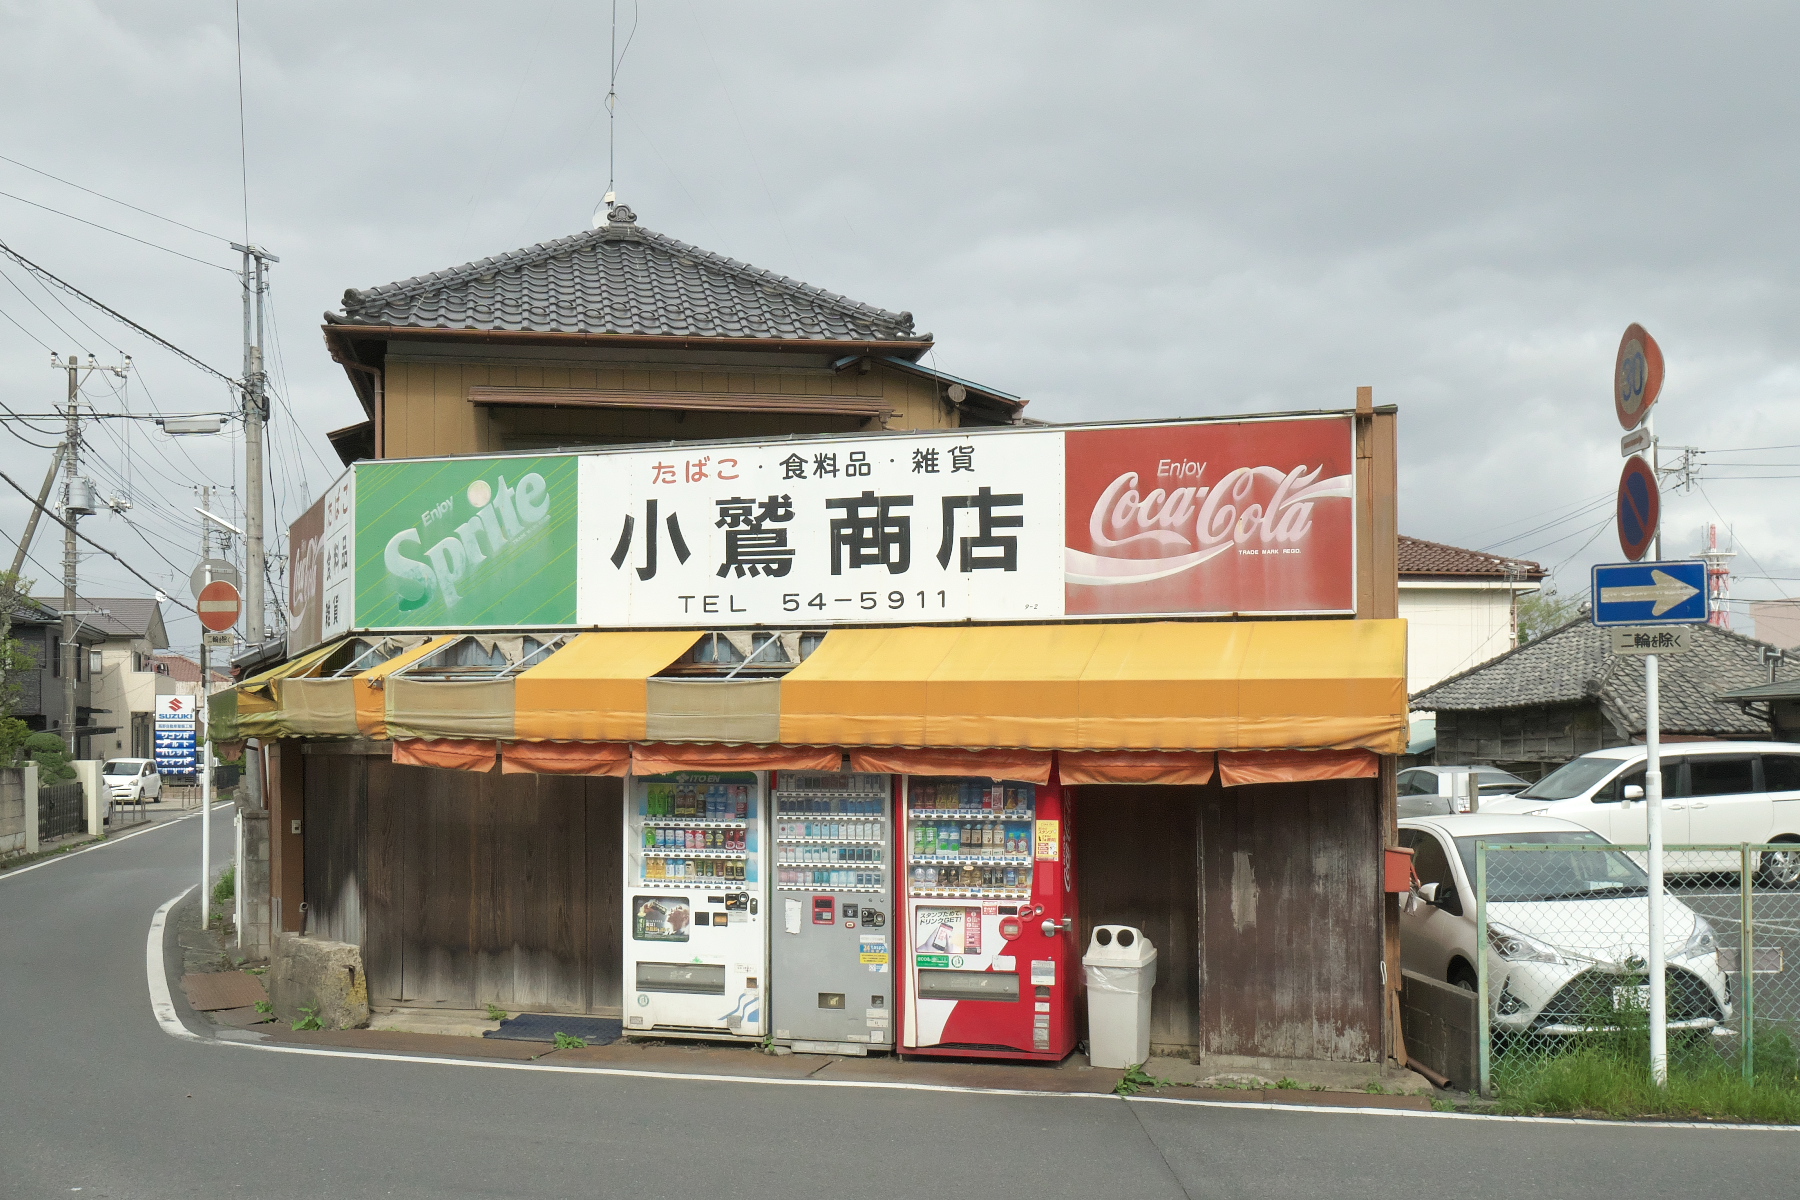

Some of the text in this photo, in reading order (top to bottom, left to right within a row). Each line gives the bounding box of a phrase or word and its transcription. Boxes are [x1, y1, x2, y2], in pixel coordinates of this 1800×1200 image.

[1623, 352, 1644, 401] 30
[1157, 459, 1206, 479] Enjoy
[421, 496, 454, 527] Enjoy
[1090, 463, 1323, 547] Coca-Cola
[383, 472, 550, 612] Sprite
[610, 487, 1024, 582] 小鷲商店
[327, 535, 348, 581] 食料品
[678, 590, 946, 613] TEL 54-5911
[1620, 632, 1682, 648] 二輪を除く
[690, 774, 720, 783] ITO EN
